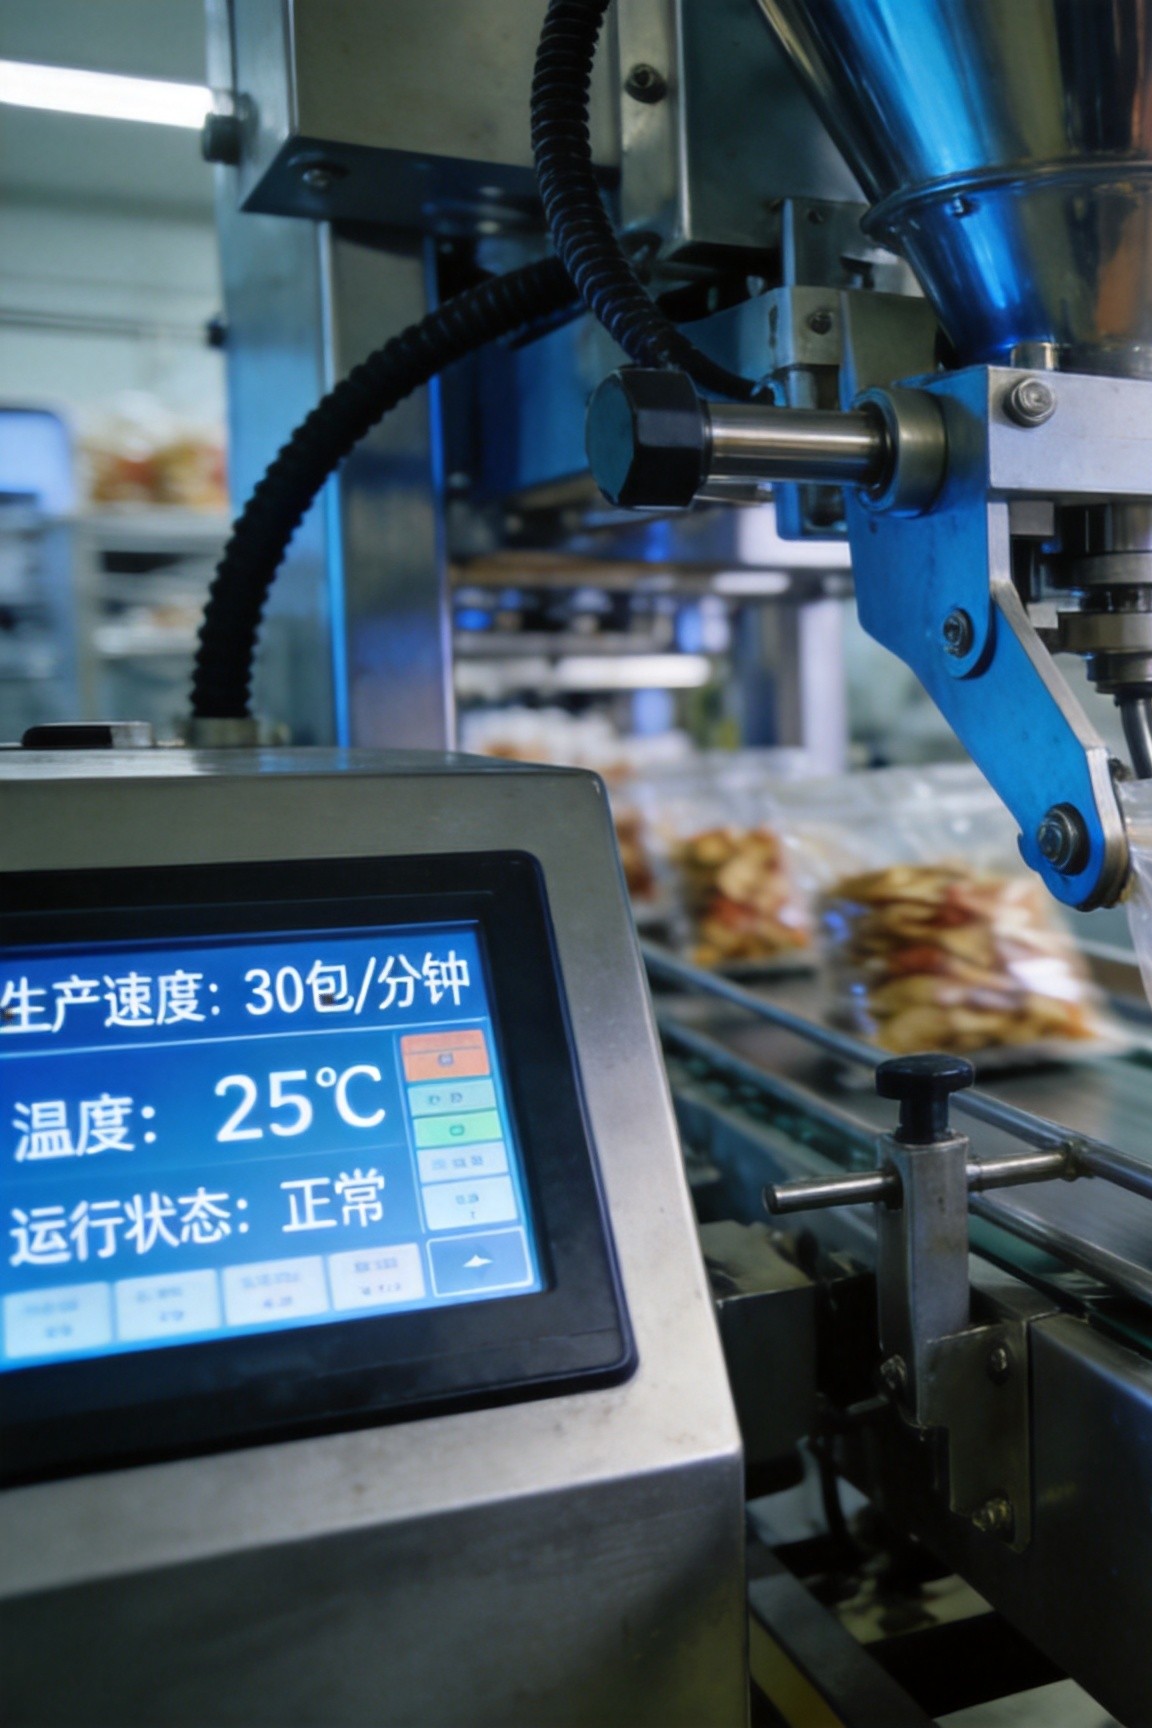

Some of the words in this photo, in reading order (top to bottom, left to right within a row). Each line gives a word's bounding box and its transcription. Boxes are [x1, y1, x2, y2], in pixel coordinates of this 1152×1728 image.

[244, 950, 471, 1014] 30包/分钟
[13, 1093, 157, 1162] 温度：
[9, 1187, 249, 1267] 运行状态：
[279, 1168, 386, 1233] 正常
